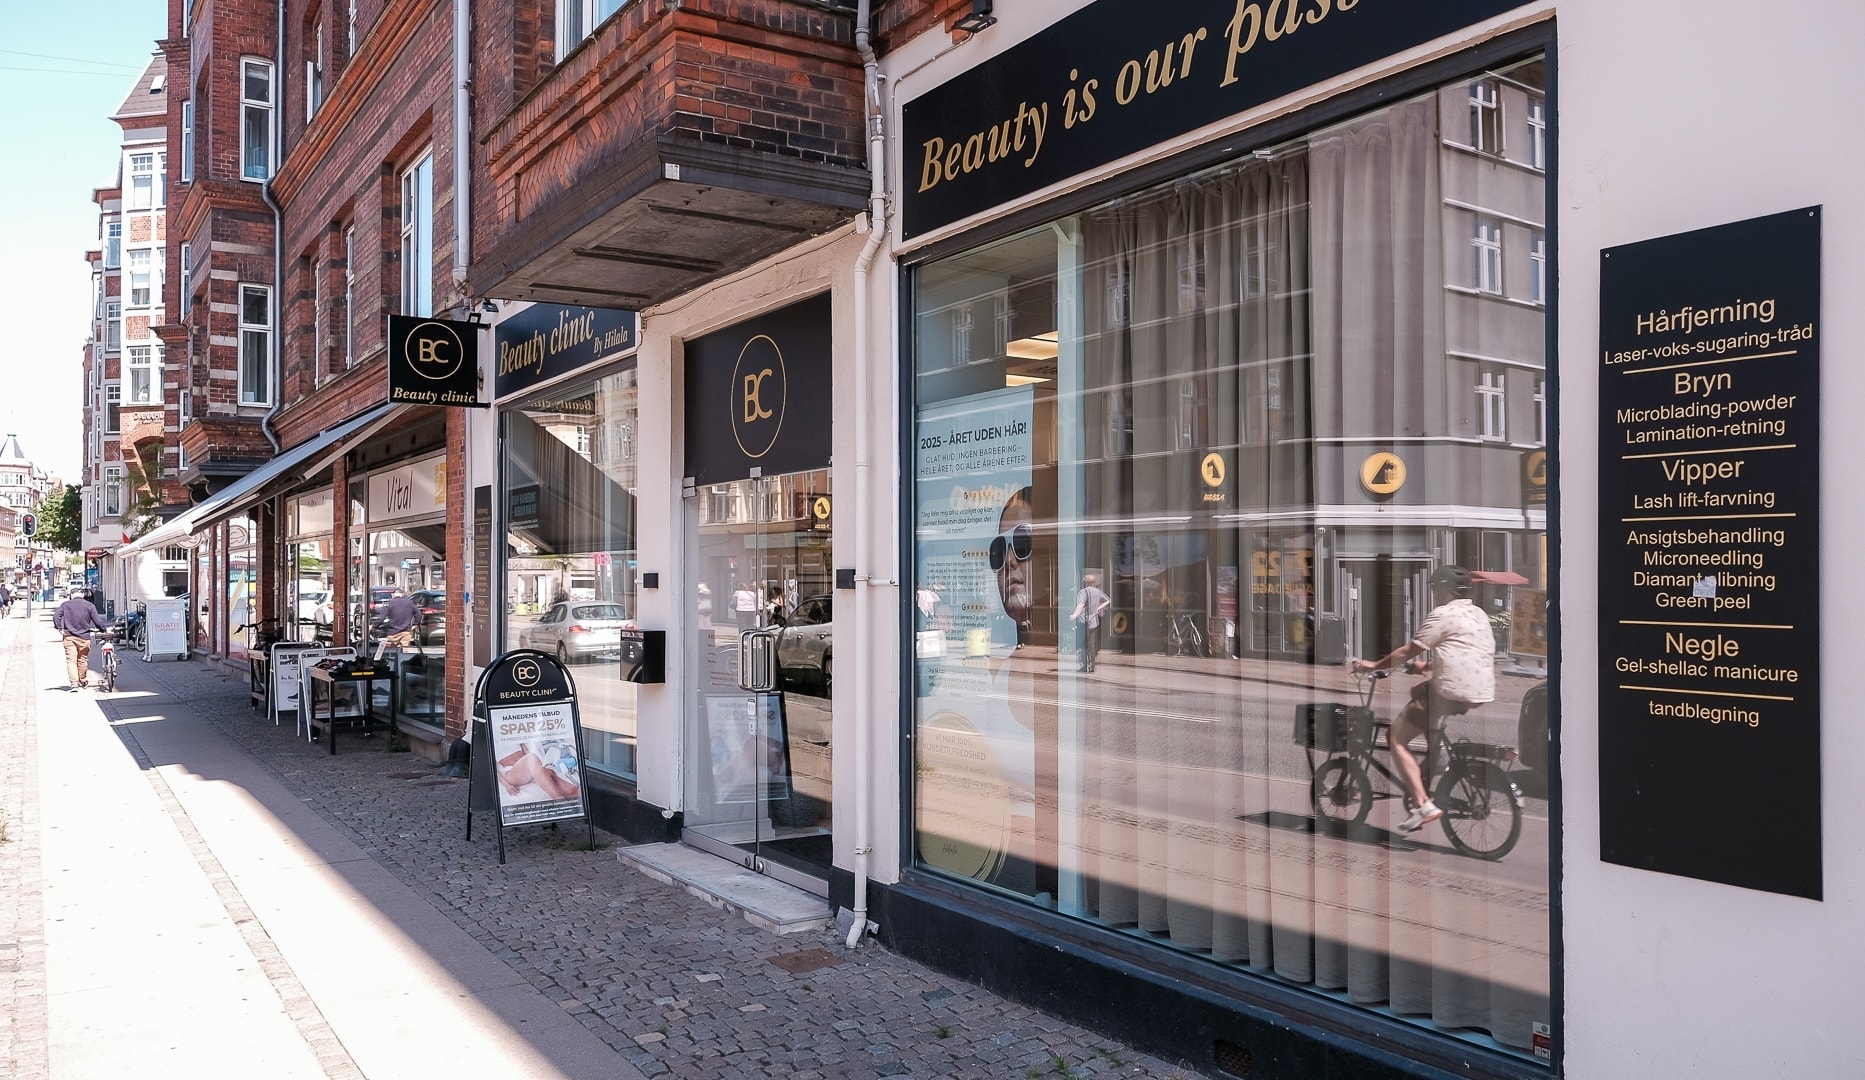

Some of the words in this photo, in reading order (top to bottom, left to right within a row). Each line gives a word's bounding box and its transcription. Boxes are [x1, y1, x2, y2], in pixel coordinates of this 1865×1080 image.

[918, 101, 1049, 194] Beauty
[1062, 68, 1099, 130] is
[1114, 26, 1207, 106] our
[1219, 0, 1361, 88] pa
[1637, 299, 1775, 335] Hårfjerning
[419, 338, 449, 364] BC
[498, 329, 546, 377] Beauty
[550, 306, 595, 355] clinic
[593, 336, 603, 357] By
[604, 326, 628, 349] Hilala
[1605, 323, 1813, 365] Laser-voks-sugaring-tråd
[393, 387, 438, 404] Beauty
[441, 390, 475, 403] clinic
[744, 368, 773, 423] BC
[1674, 372, 1731, 398] Bryn
[1617, 394, 1796, 423] Microblading-powder
[920, 435, 942, 450] 2025
[948, 429, 973, 446] ÅRET
[974, 426, 1002, 442] UDEN
[1004, 420, 1027, 439] HÅR!
[1626, 418, 1786, 444] Lamination-retning
[920, 465, 937, 475] HELE
[955, 461, 965, 471] OG
[966, 458, 981, 470] ALLE
[982, 456, 1005, 468] ÅRENE
[925, 454, 941, 464] GLAT
[958, 449, 978, 460] INGEN
[979, 444, 1017, 456] BARBERING
[1661, 459, 1745, 485] Vipper
[387, 469, 414, 514] Vital
[1634, 493, 1672, 509] Lash
[1678, 490, 1775, 508] lift-farvning
[1626, 528, 1785, 548] Ansigtsbehandling
[1643, 550, 1764, 569] Microneedling
[1633, 571, 1776, 591] Diamantlibning
[1655, 593, 1707, 608] Green
[1713, 594, 1751, 612] peel
[1665, 632, 1740, 661] Negle
[517, 666, 536, 680] BC
[1615, 657, 1708, 677] Gel-shellac
[1714, 665, 1799, 683] manicure
[500, 690, 530, 699] BEAUTY
[531, 688, 557, 697] CLINI
[500, 721, 535, 736] SPAR
[537, 718, 566, 731] 25%
[502, 712, 538, 721] MÅNEDENS
[538, 710, 561, 718] ILBUD
[1648, 700, 1760, 728] tandblegning
